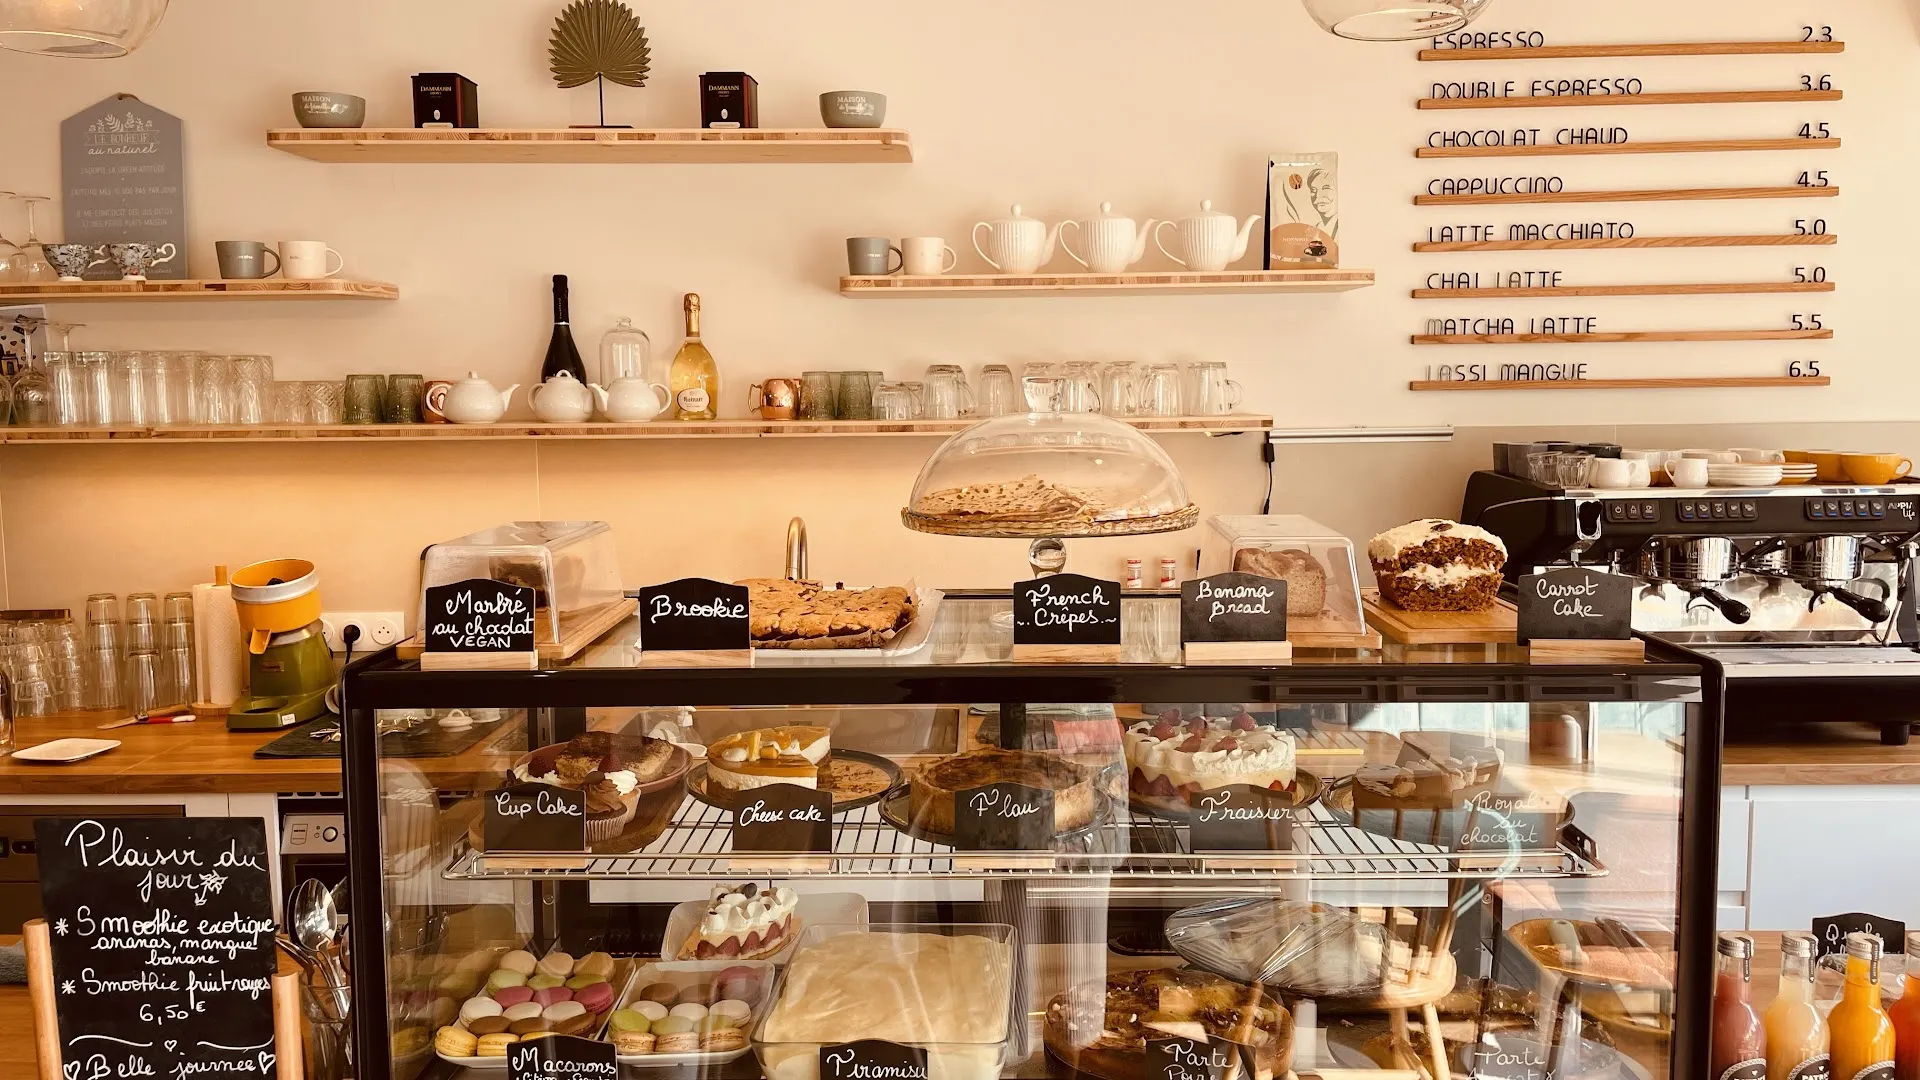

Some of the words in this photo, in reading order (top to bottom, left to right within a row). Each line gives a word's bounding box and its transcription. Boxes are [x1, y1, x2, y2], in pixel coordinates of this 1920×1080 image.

[1433, 31, 1544, 49] ESPRESSO
[1802, 26, 1832, 42] 2.3
[1433, 82, 1514, 100] DOUBLE
[1532, 78, 1642, 97] ESPRESSO
[1800, 75, 1831, 91] 3.6
[1428, 129, 1540, 148] CHOCOLAT
[1556, 127, 1628, 145] CHAUD
[1798, 122, 1829, 139] 4.5
[107, 143, 158, 154] naturel
[1428, 176, 1563, 196] CAPPUCCINO
[1797, 171, 1828, 188] 4.5
[1429, 225, 1494, 242] LATTE
[1509, 222, 1634, 241] MACCHIATO
[1794, 219, 1826, 236] 5.0
[1427, 272, 1478, 289] CHAI
[1496, 271, 1562, 288] LATTE
[1794, 267, 1826, 284] 5.0
[1427, 318, 1514, 336] MATCHA
[1531, 317, 1597, 334] LATTE
[1791, 314, 1822, 331] 5.5
[1427, 364, 1486, 381] LASSI
[1500, 363, 1587, 381] MANGUE
[1789, 361, 1820, 378] 6.5
[1026, 584, 1110, 607] French
[1196, 580, 1274, 601] Banana
[1536, 575, 1599, 598] Carrot
[446, 588, 526, 615] Marbré
[650, 594, 748, 623] Brookie
[1208, 600, 1271, 622] Bread
[1553, 597, 1604, 617] Cake
[432, 623, 459, 635] au
[465, 612, 535, 635] chocolat
[449, 635, 511, 648] VEGAN
[495, 792, 531, 819] Cup
[536, 790, 582, 817] Cake
[740, 799, 784, 826] Cheese
[789, 804, 826, 823] cake
[1200, 790, 1293, 822] Fraisier
[1472, 790, 1539, 818] Royal
[1461, 825, 1538, 845] chocolat
[1493, 818, 1527, 829] au
[65, 819, 203, 867] Plaisir
[213, 839, 266, 872] du
[137, 868, 200, 903] jour
[77, 905, 189, 936] Smoothie
[197, 911, 275, 945] exotique
[145, 948, 219, 966] banane
[179, 938, 257, 960] mangue
[82, 967, 180, 995] Smoothie
[512, 1046, 617, 1073] Macarons
[826, 1048, 929, 1079] Tiramisu
[1164, 1040, 1234, 1068] Tarte
[85, 1053, 156, 1080] Belle
